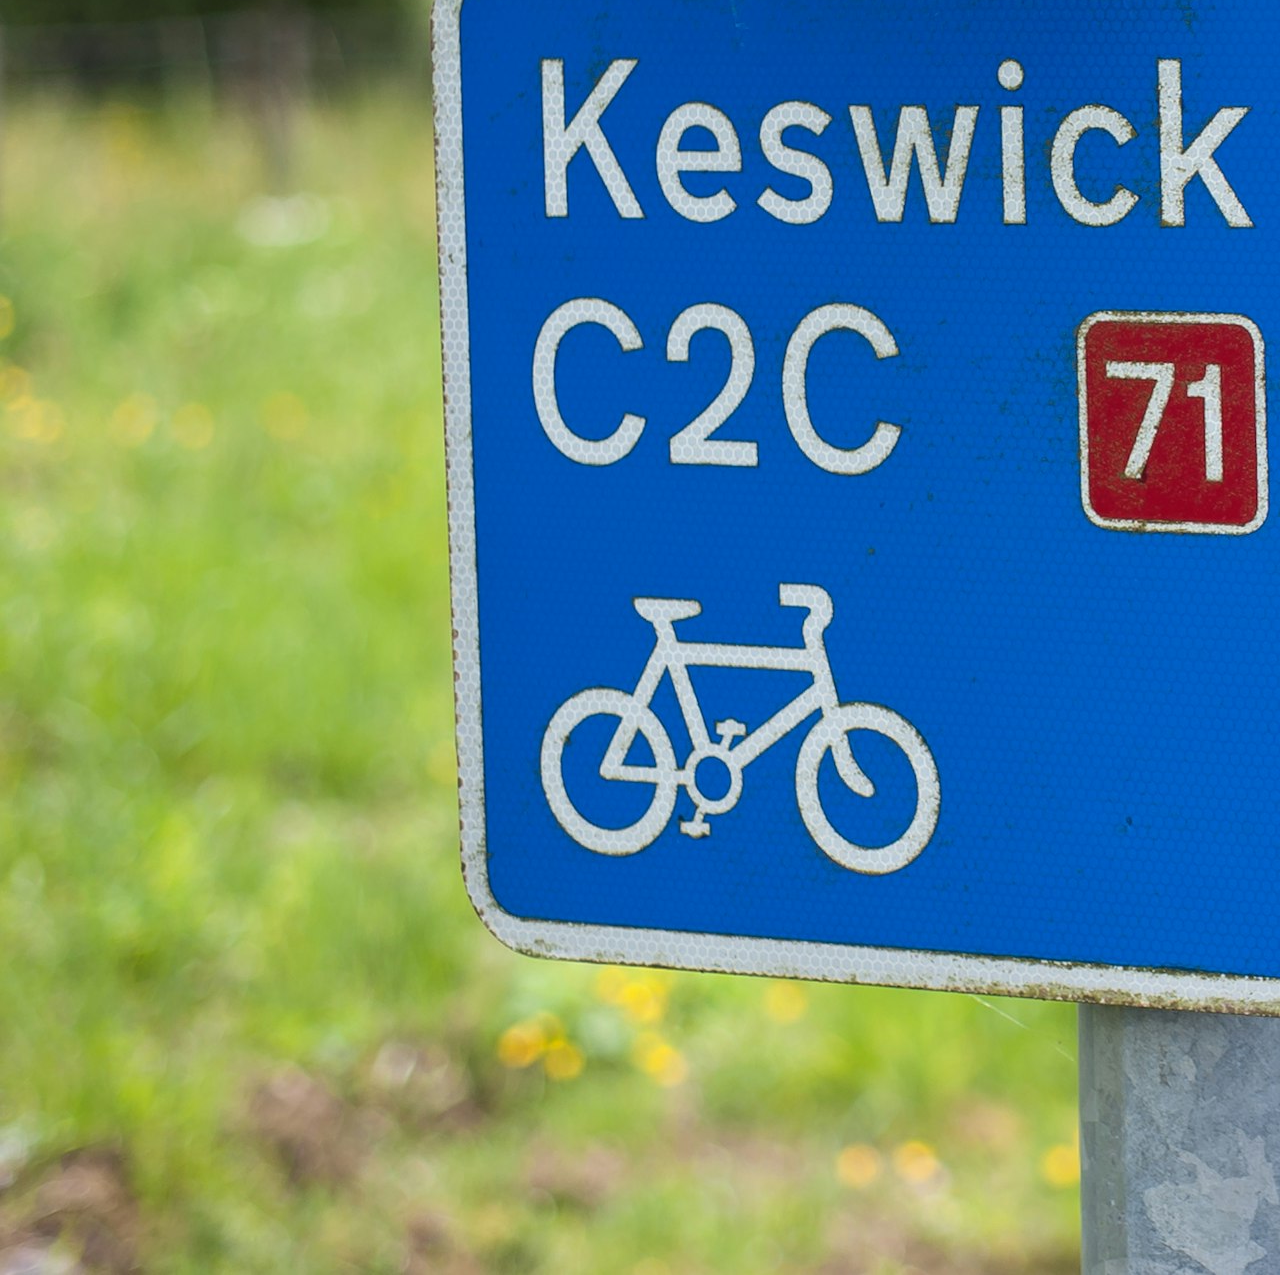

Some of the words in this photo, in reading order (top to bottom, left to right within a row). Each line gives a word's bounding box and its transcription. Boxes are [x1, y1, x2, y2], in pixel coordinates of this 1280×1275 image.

[542, 59, 1252, 227] Keswick
[533, 298, 900, 474] C2C
[1106, 361, 1223, 481] 71
